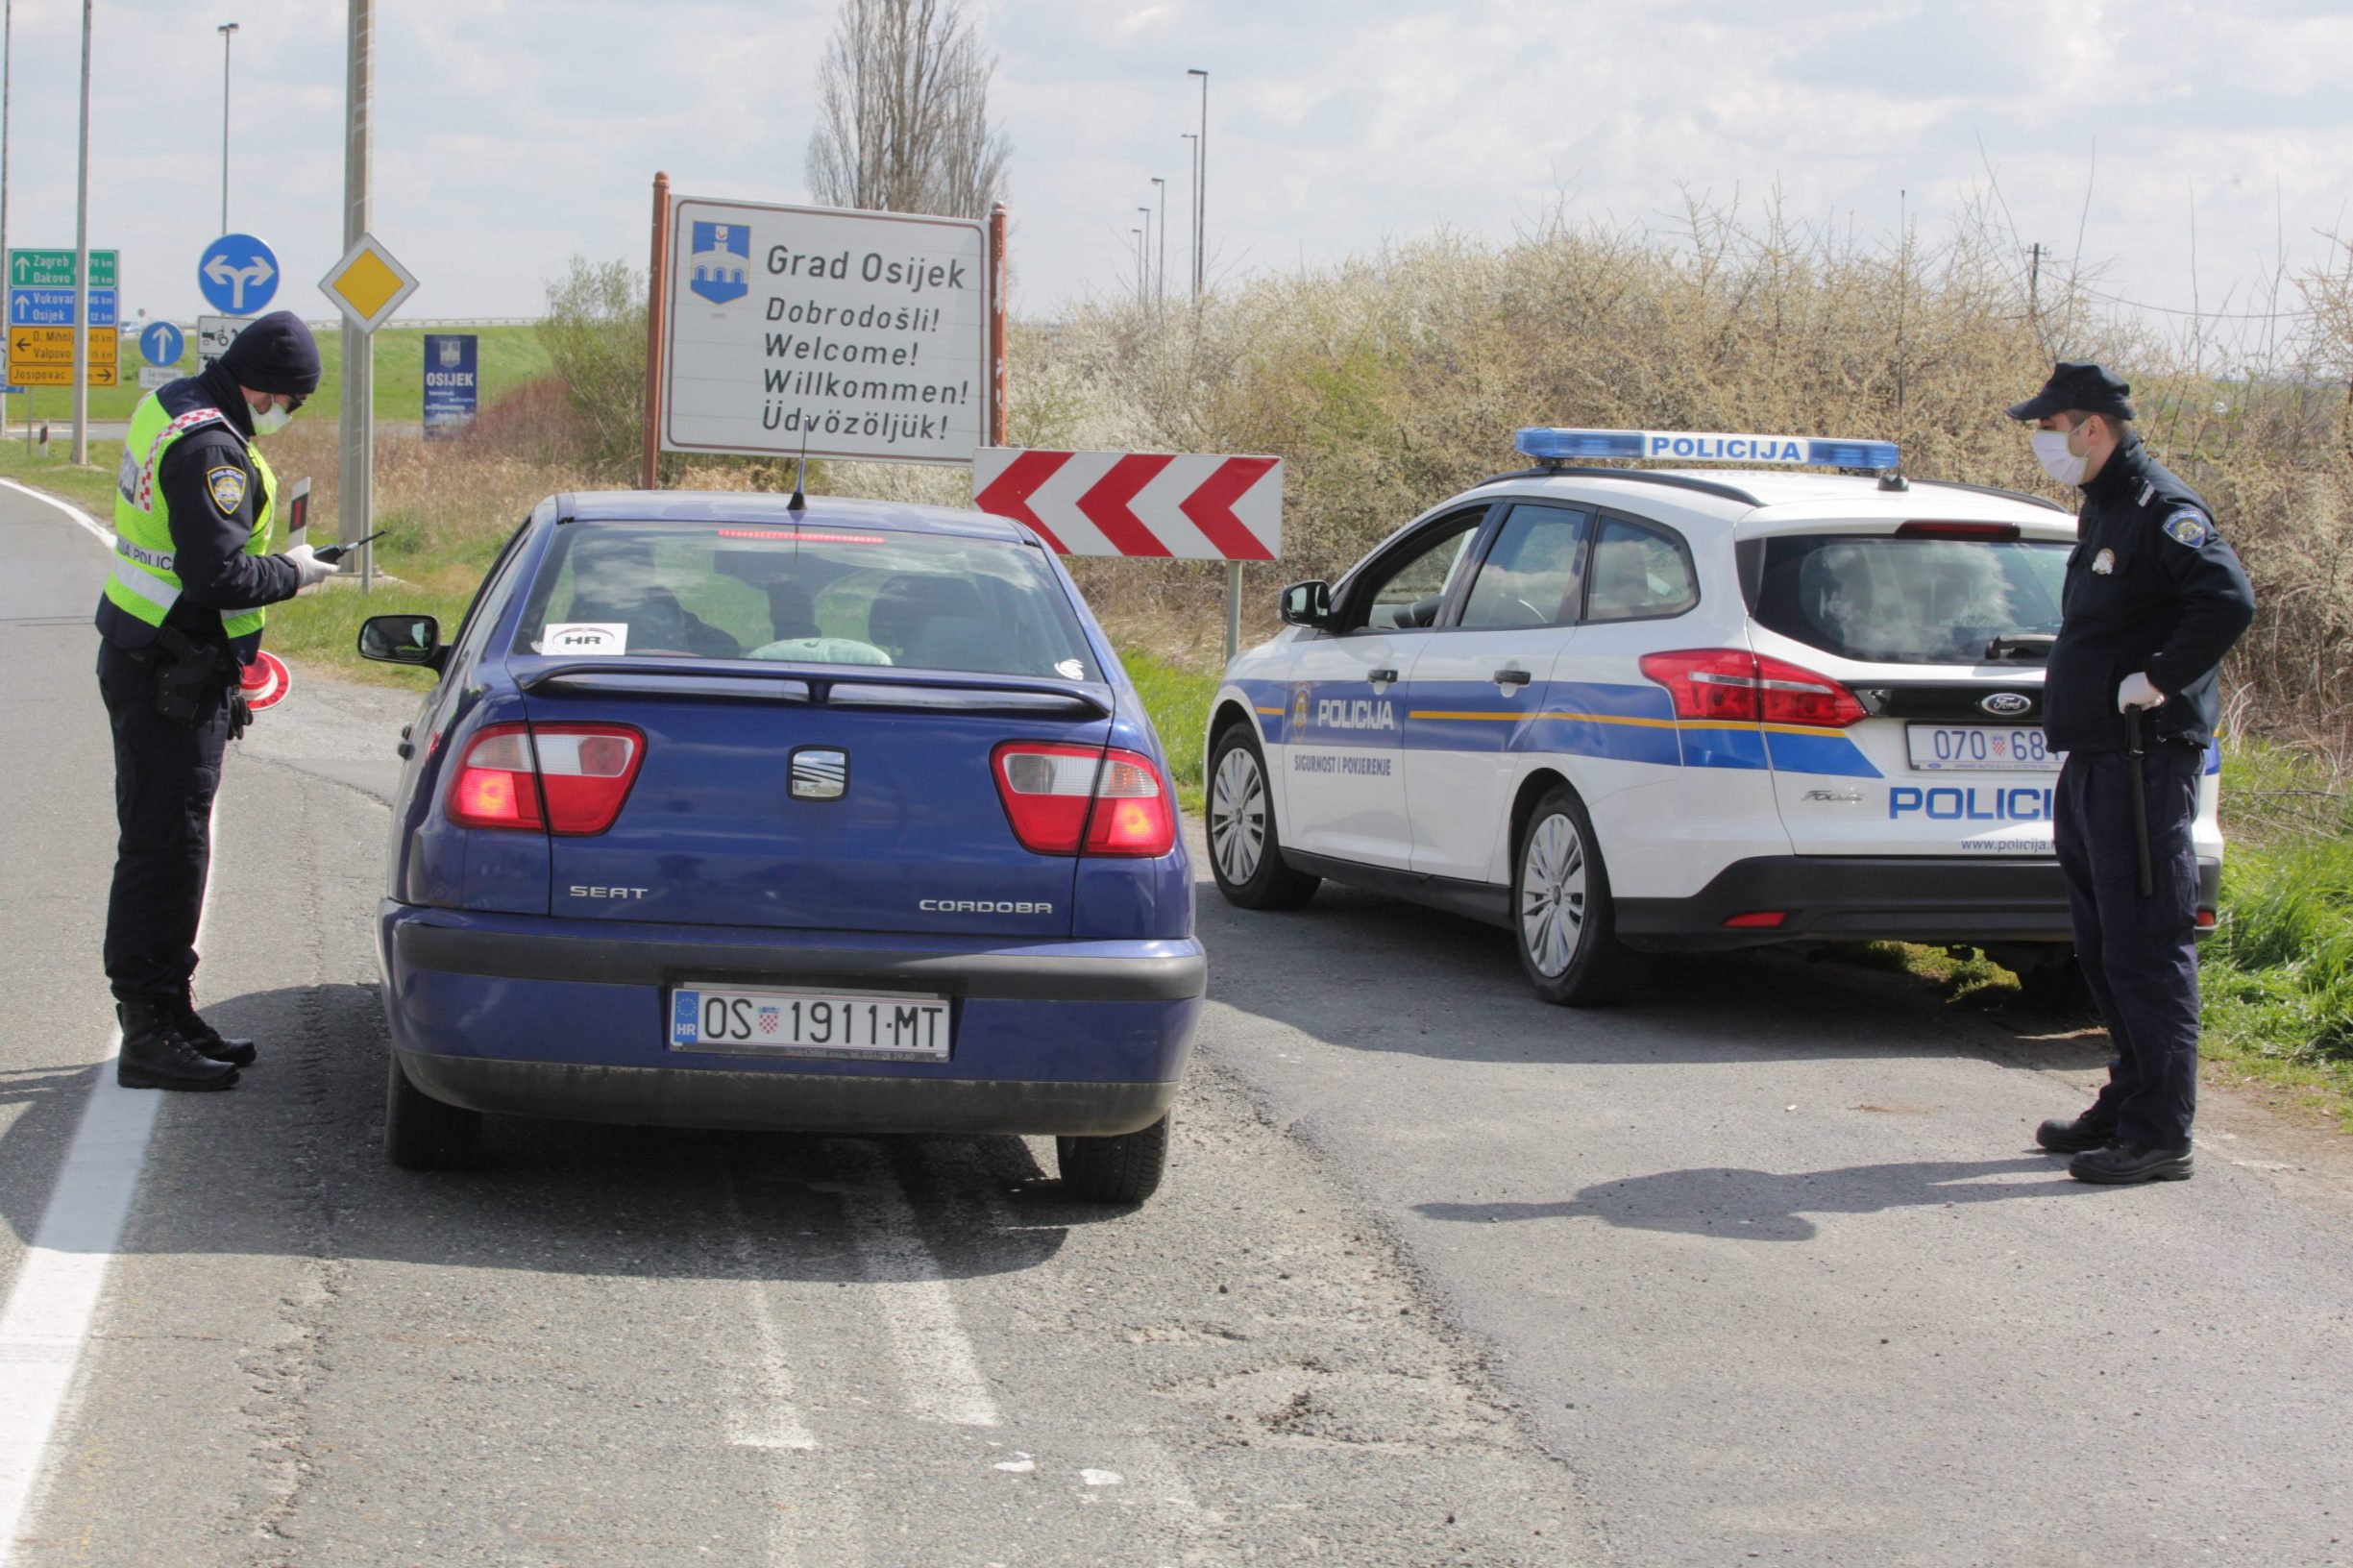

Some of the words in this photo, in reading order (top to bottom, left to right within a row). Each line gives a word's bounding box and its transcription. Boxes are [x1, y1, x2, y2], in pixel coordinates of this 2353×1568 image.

[33, 255, 69, 270] Zagreb
[766, 244, 850, 281] Grad
[862, 252, 967, 293] Osijek
[102, 276, 113, 284] km
[33, 292, 74, 305] Vukovar
[102, 295, 113, 305] km
[33, 309, 65, 323] Osijek
[90, 312, 99, 321] 12
[102, 312, 113, 321] km
[766, 297, 941, 332] Dobrodošli!
[46, 331, 74, 345] Miholj
[34, 348, 71, 361] Valpovo
[765, 332, 919, 367] Welcome!
[13, 370, 66, 382] Josipovac
[427, 372, 474, 386] OSIJEK
[763, 368, 968, 405] Willkommen!
[762, 400, 948, 444] Üdvözöljük!
[1651, 436, 1802, 461] POLICIJA
[133, 548, 172, 571] POLIC
[564, 636, 601, 646] HR
[1993, 697, 2022, 710] Ford
[1317, 698, 1395, 730] POLICIJA
[1933, 729, 1987, 761] 070
[1294, 754, 1336, 773] SIGURNOST
[1342, 757, 1392, 776] POVJERENJE
[1802, 789, 1865, 802] Focus
[1889, 787, 2052, 821] POLICI
[1961, 838, 2056, 853] www.policija.
[569, 885, 649, 900] SEAT
[919, 898, 1053, 915] CORDOBA
[704, 996, 752, 1041] OS
[676, 1023, 697, 1036] HR
